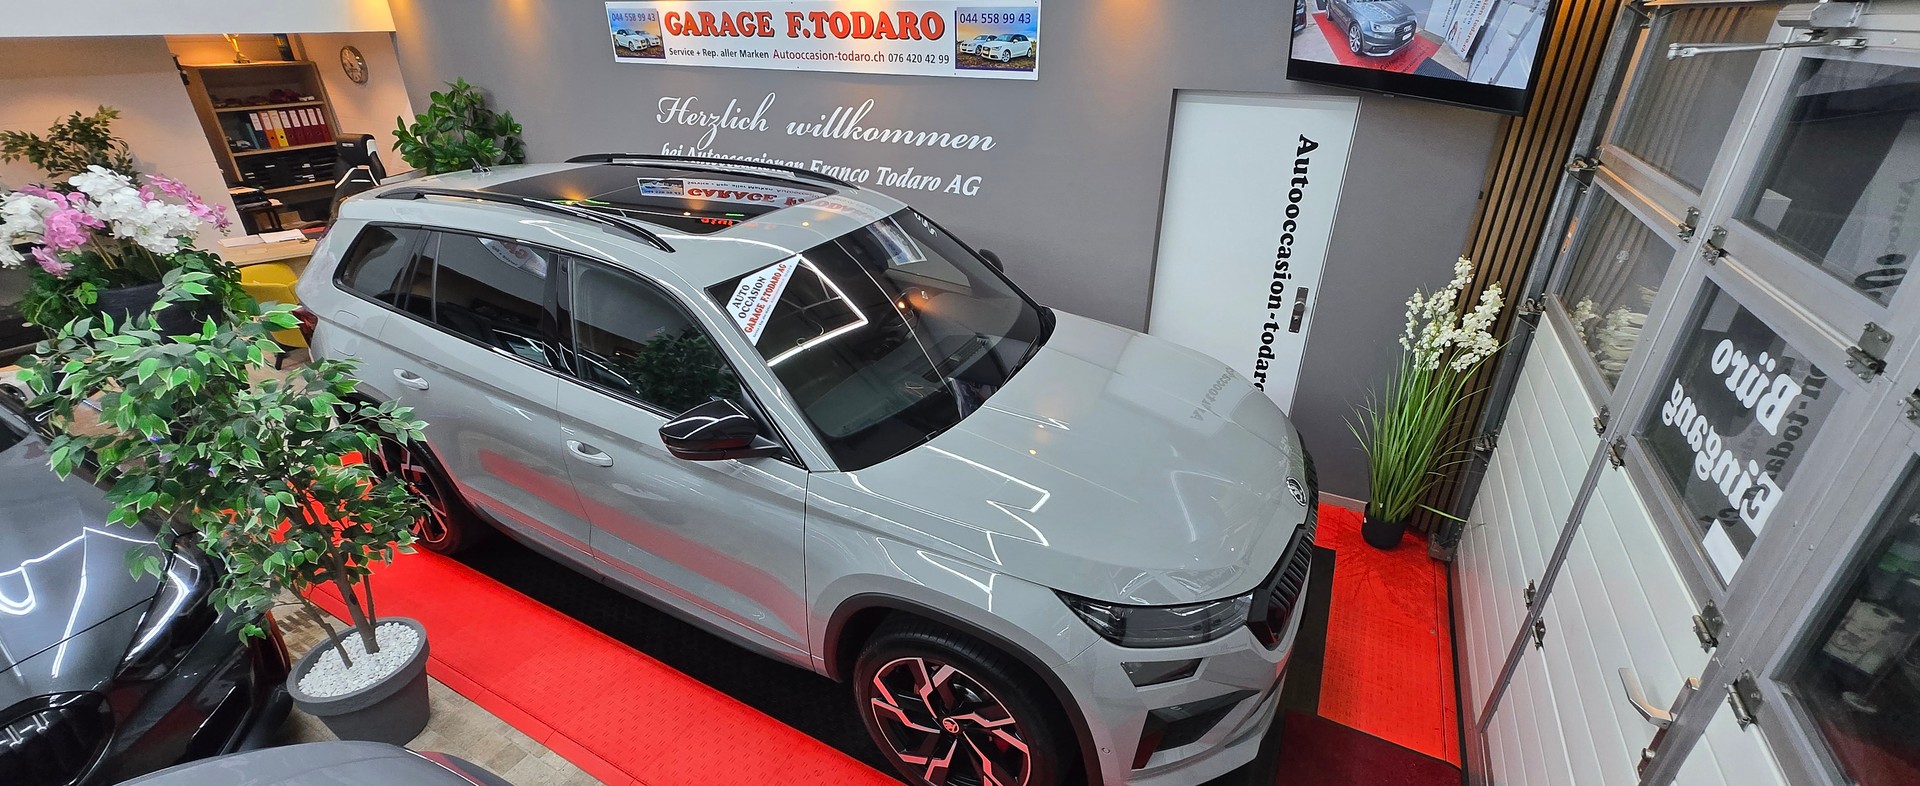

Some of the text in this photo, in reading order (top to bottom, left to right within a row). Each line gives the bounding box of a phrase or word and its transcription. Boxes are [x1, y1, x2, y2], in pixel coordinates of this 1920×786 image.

[611, 12, 656, 22] 044 558 99 43
[664, 10, 946, 40] GARAGE F.TODARO
[959, 13, 1031, 24] 044 558 99 43
[669, 47, 695, 57] Service
[702, 48, 718, 59] Rep.
[720, 49, 738, 58] aller
[739, 49, 770, 59] Marken
[772, 49, 885, 63] Autooccasion-todaro.ch
[888, 53, 904, 63] 076
[906, 54, 923, 64] 420
[924, 54, 936, 64] 42
[938, 54, 950, 65] 99
[656, 92, 997, 151] Herzlich willkommen
[809, 159, 870, 184] Franco
[875, 166, 942, 192] Todaro
[944, 173, 983, 197] AG
[732, 284, 751, 309] AUTO
[738, 276, 767, 319] OCCASION
[744, 302, 766, 334] GARAGE
[760, 271, 782, 303] F.TODARO
[777, 263, 788, 273] AG
